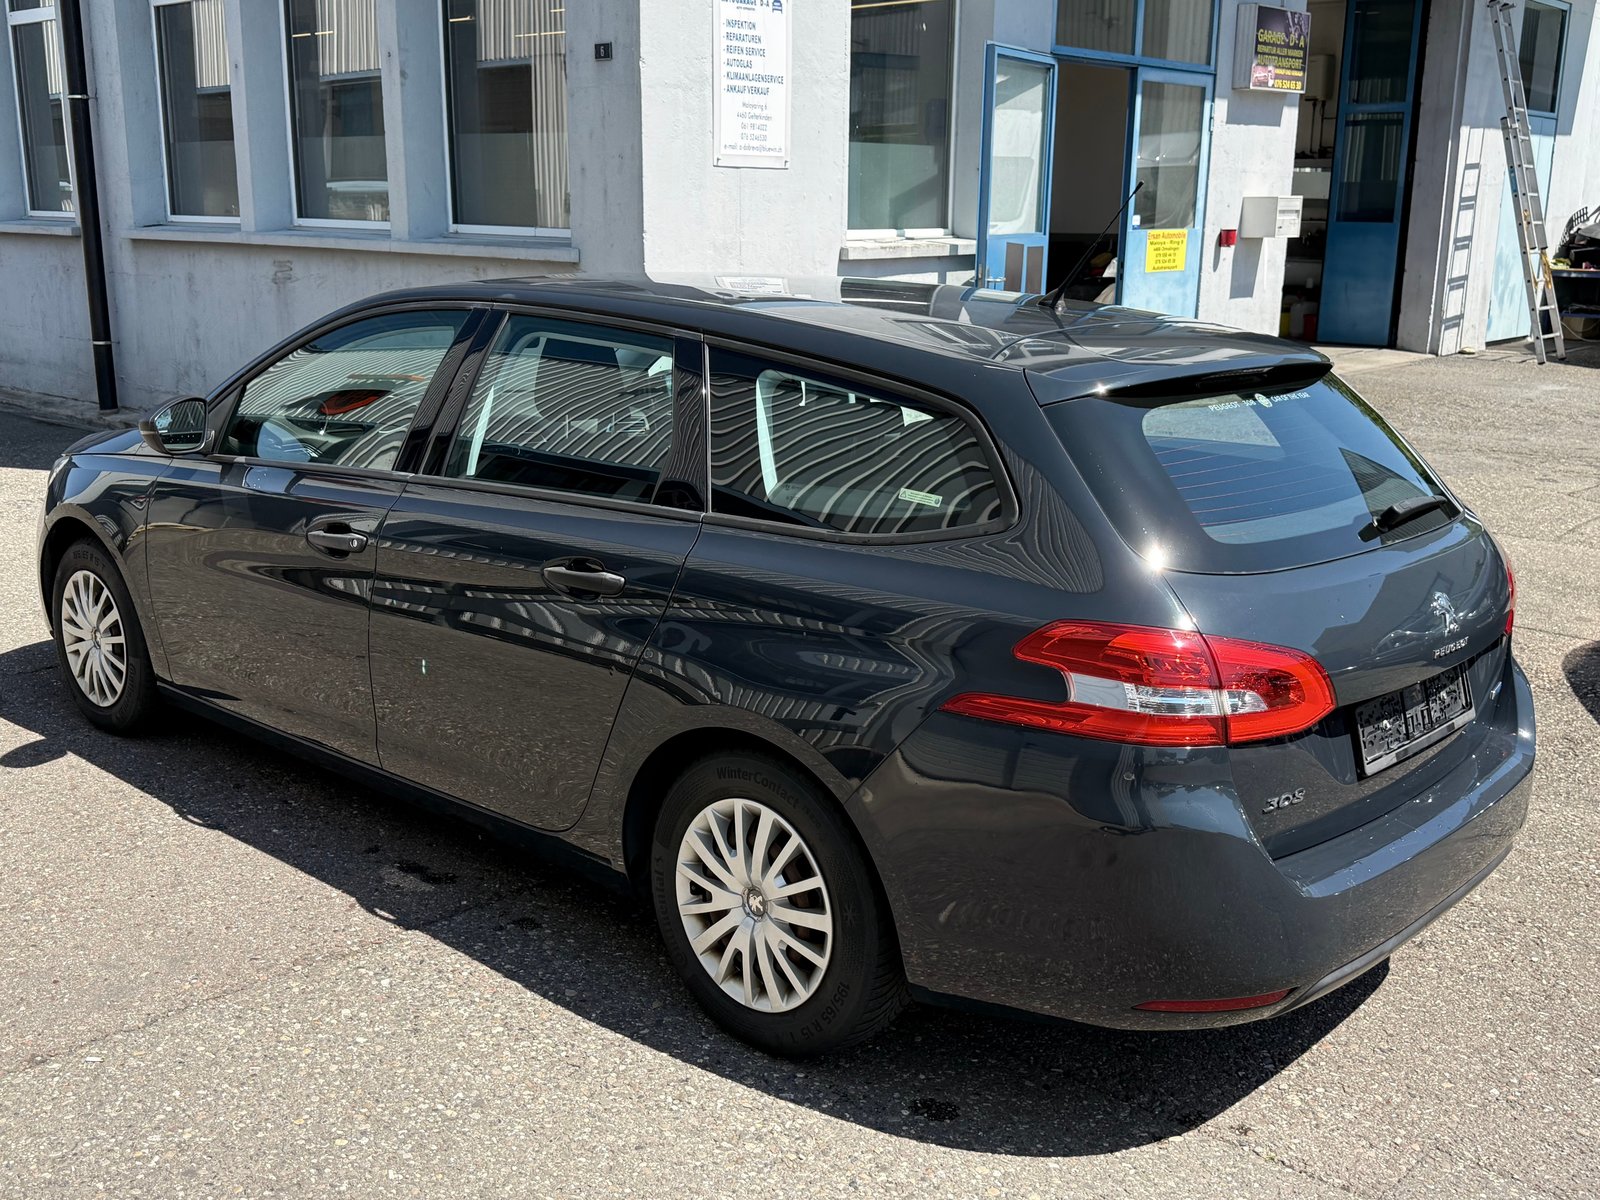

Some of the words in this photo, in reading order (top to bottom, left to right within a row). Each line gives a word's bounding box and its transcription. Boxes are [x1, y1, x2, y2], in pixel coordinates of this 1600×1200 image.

[726, 18, 756, 30] INSPEKTION
[726, 32, 761, 44] REPARATUREN
[1258, 28, 1285, 45] GARAGE
[600, 46, 604, 56] 6
[726, 45, 744, 55] REIFEN
[745, 47, 766, 57] SERVICE
[726, 58, 752, 69] AUTOGLAS
[1258, 54, 1302, 69] AUTOTRANSPORT
[726, 71, 784, 84] KLIMAANLAGENSERVICE
[726, 84, 746, 94] ANKAUF
[747, 86, 770, 95] VERKAUF
[1208, 401, 1240, 412] PEUGEOT
[1242, 399, 1257, 407] 308
[1433, 635, 1469, 660] PEUGEOT
[716, 766, 800, 809] WinterContact
[821, 981, 850, 1024] 195/65
[800, 1025, 814, 1040] 15
